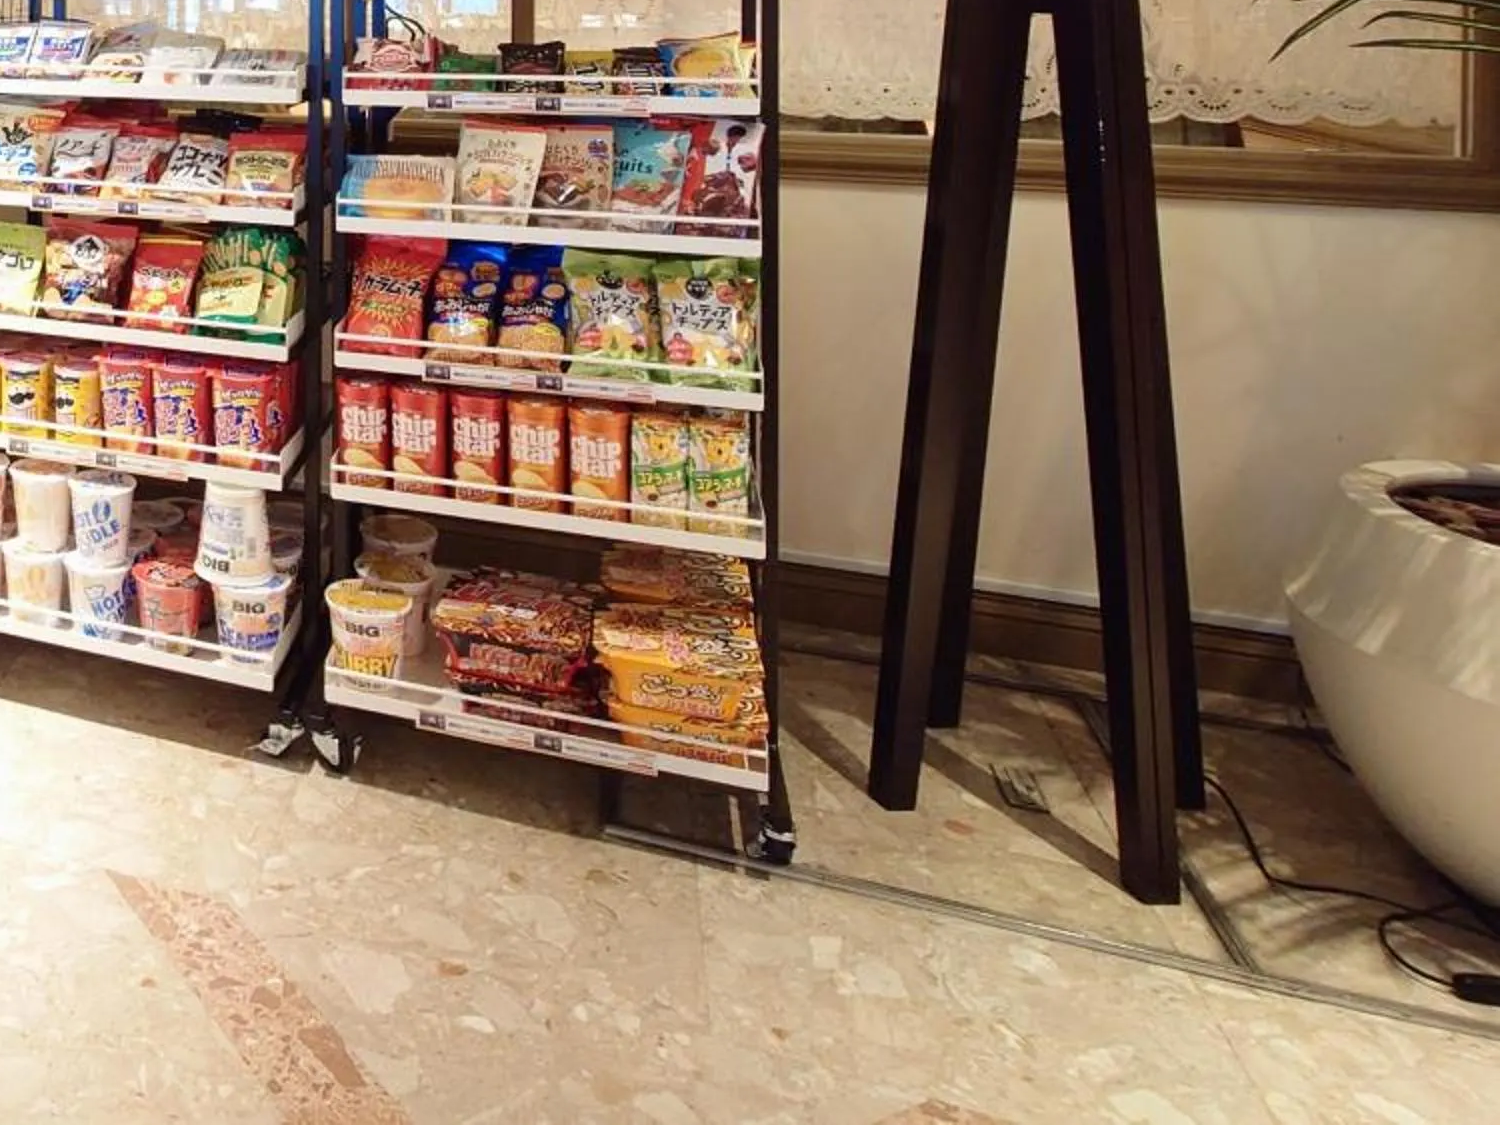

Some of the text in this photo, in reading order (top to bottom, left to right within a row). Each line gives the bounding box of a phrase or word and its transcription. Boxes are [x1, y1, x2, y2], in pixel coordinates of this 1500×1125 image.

[342, 405, 387, 426] chip
[392, 412, 437, 435] chip
[343, 424, 387, 443] star
[453, 417, 500, 440] chip
[510, 424, 560, 447] chip
[392, 431, 437, 453] star
[453, 434, 500, 457] star
[571, 435, 622, 460] chip
[510, 442, 560, 466] star
[571, 454, 622, 479] star
[232, 600, 266, 614] BIG
[345, 622, 380, 638] BIG
